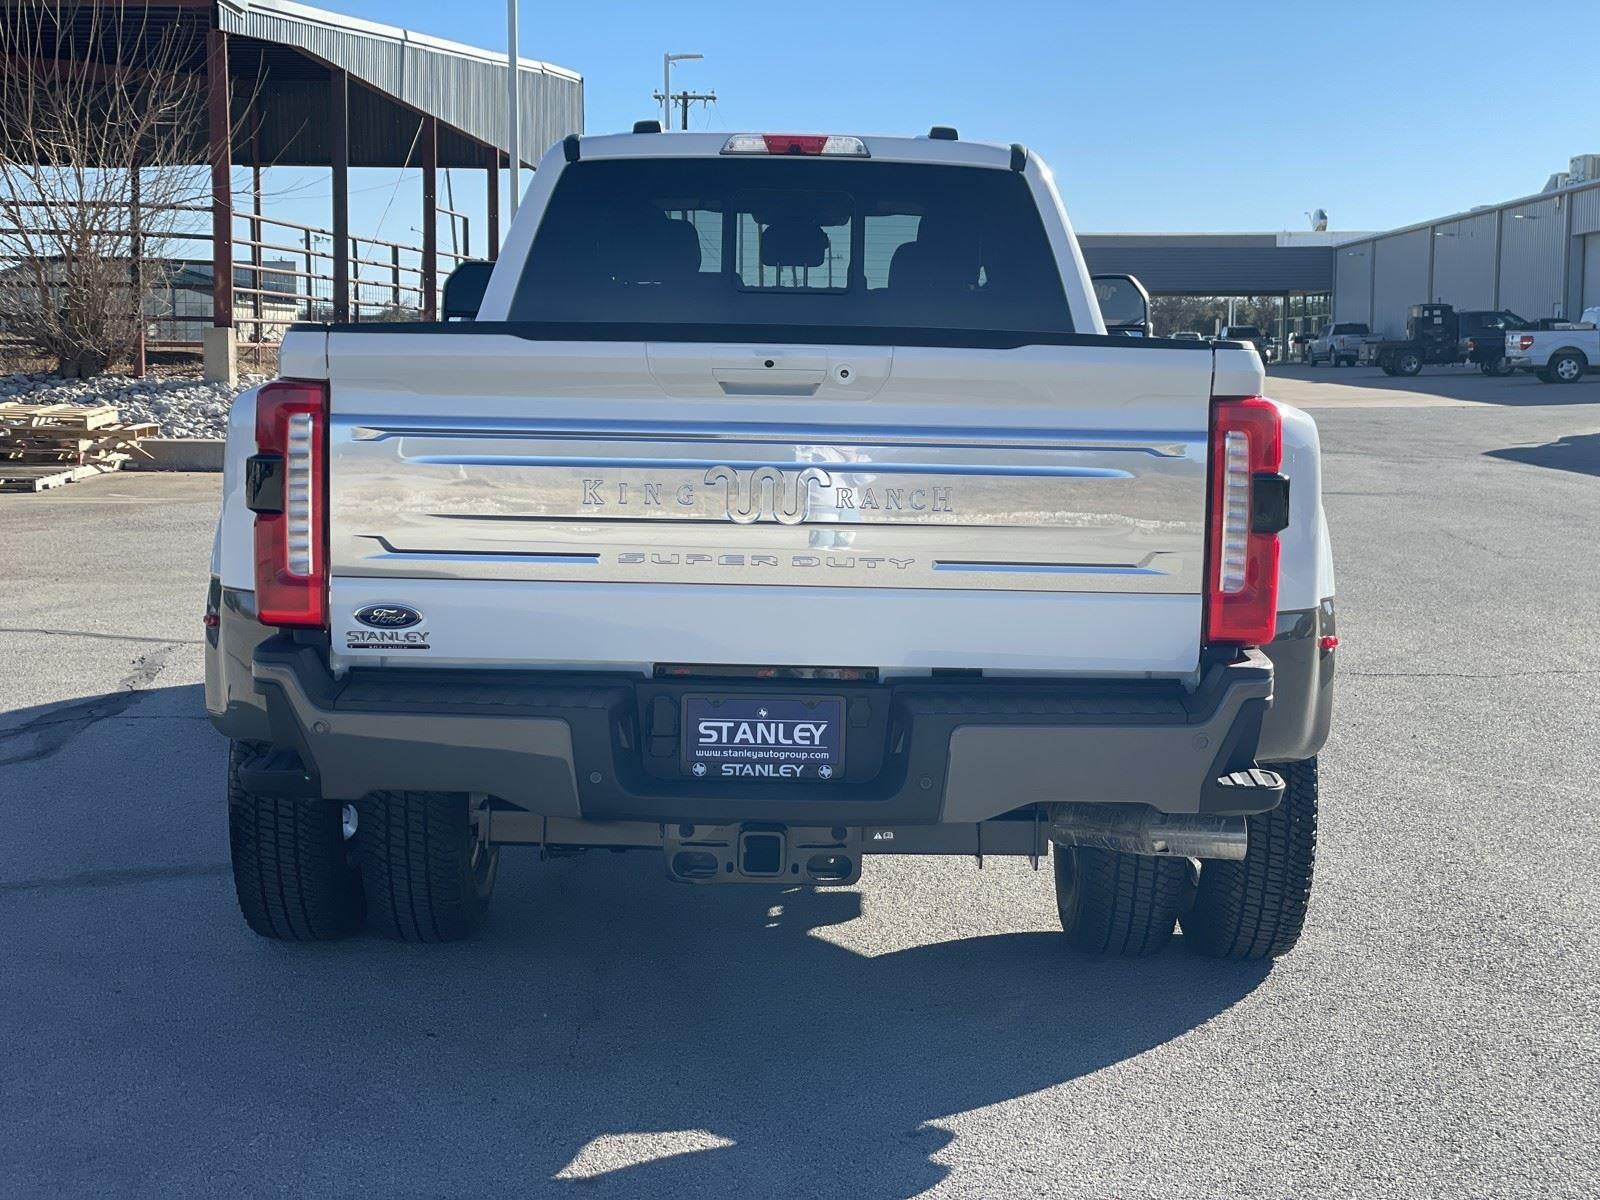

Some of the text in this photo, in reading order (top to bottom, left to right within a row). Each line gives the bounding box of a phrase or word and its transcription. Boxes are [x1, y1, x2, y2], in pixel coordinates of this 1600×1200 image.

[581, 478, 953, 512] KING RANCH
[617, 552, 916, 569] SUPER DUTY
[370, 608, 407, 624] Ford
[346, 630, 430, 643] STANLEY
[698, 721, 828, 745] STANLEY
[695, 749, 830, 760] www.stanleyautogroup.com
[721, 763, 804, 777] STANLEY
